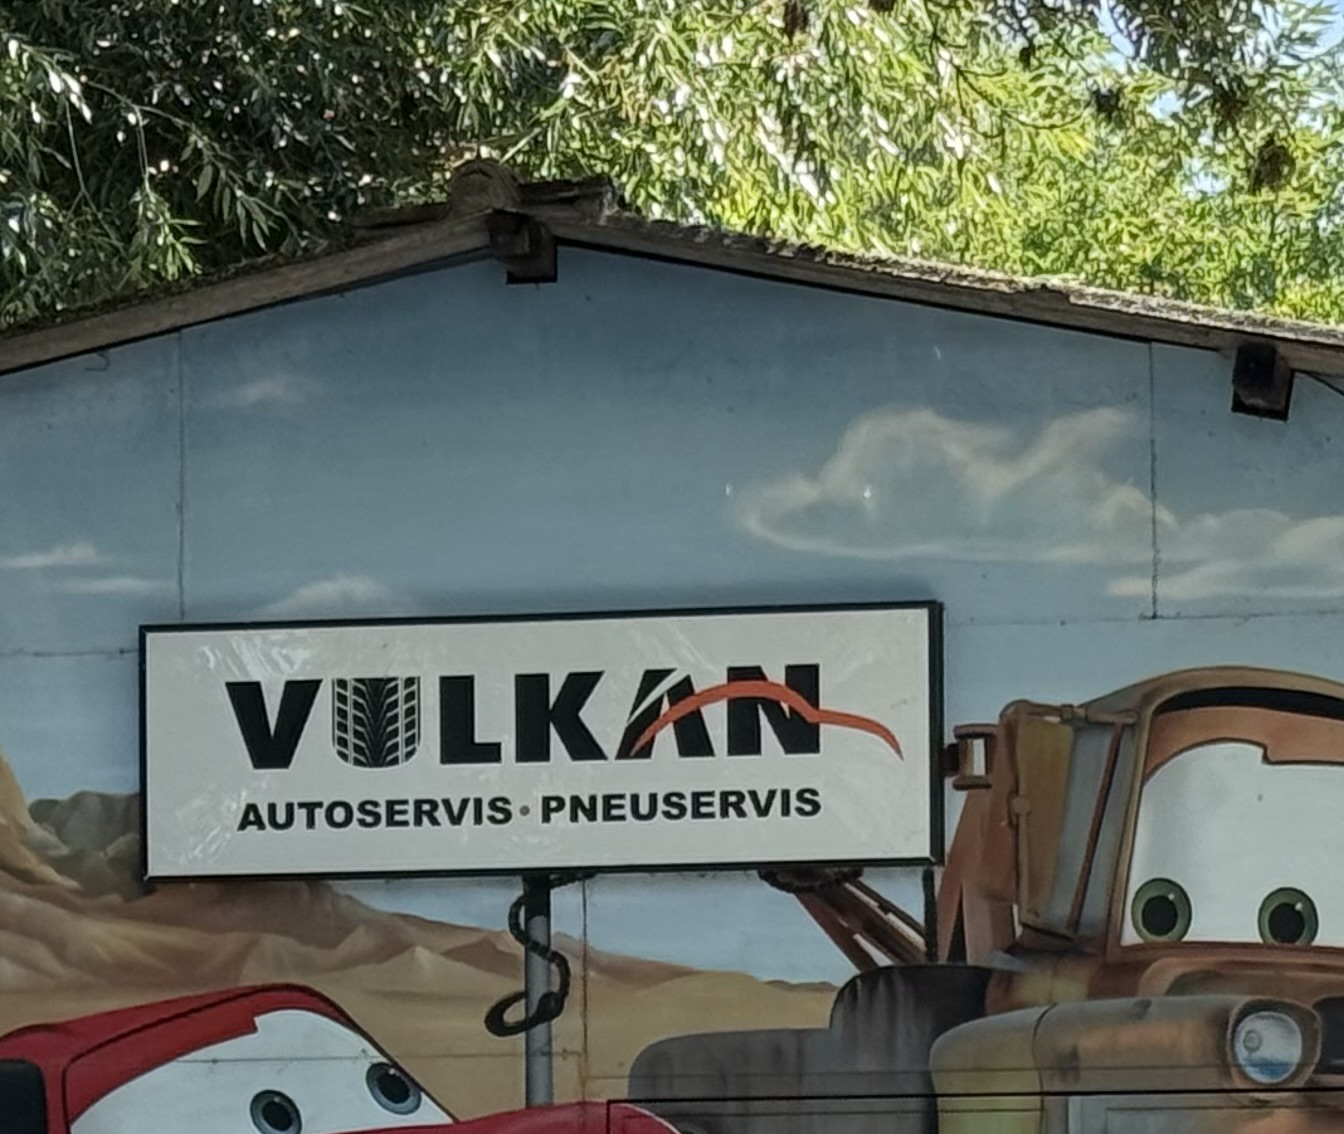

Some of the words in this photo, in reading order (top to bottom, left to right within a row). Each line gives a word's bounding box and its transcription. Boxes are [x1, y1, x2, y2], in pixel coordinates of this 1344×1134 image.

[225, 664, 822, 770] VULKAN
[237, 796, 514, 832] AUTOSERVIS
[540, 787, 822, 825] PNEUSERVIS
